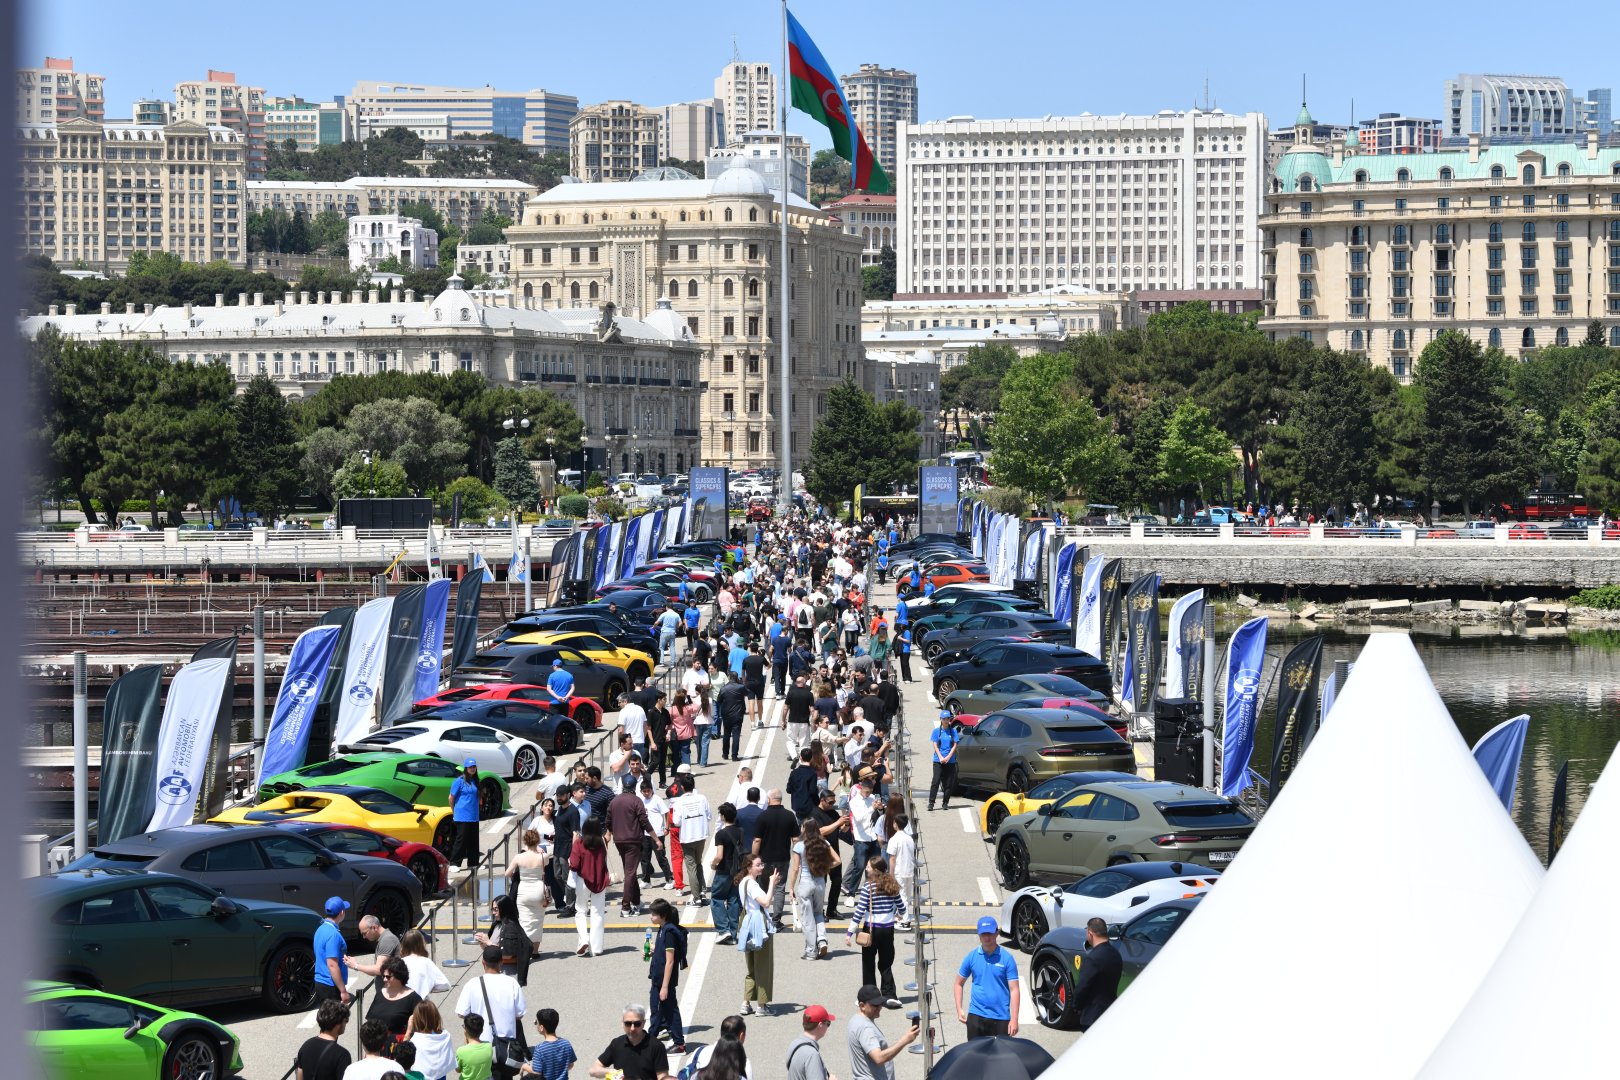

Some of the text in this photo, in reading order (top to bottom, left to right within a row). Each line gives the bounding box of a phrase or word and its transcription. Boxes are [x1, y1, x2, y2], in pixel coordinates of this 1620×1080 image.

[1136, 623, 1148, 705] NAZAR HOLDINGS
[357, 680, 367, 699] AAF
[1242, 678, 1254, 701] AAF
[172, 718, 187, 766] AZƏRBAYCAN
[178, 723, 193, 767] AVTOMOBİL
[185, 718, 199, 768] FEDERASİYASI
[1280, 707, 1297, 772] HOLDINGS
[168, 769, 185, 796] AAF
